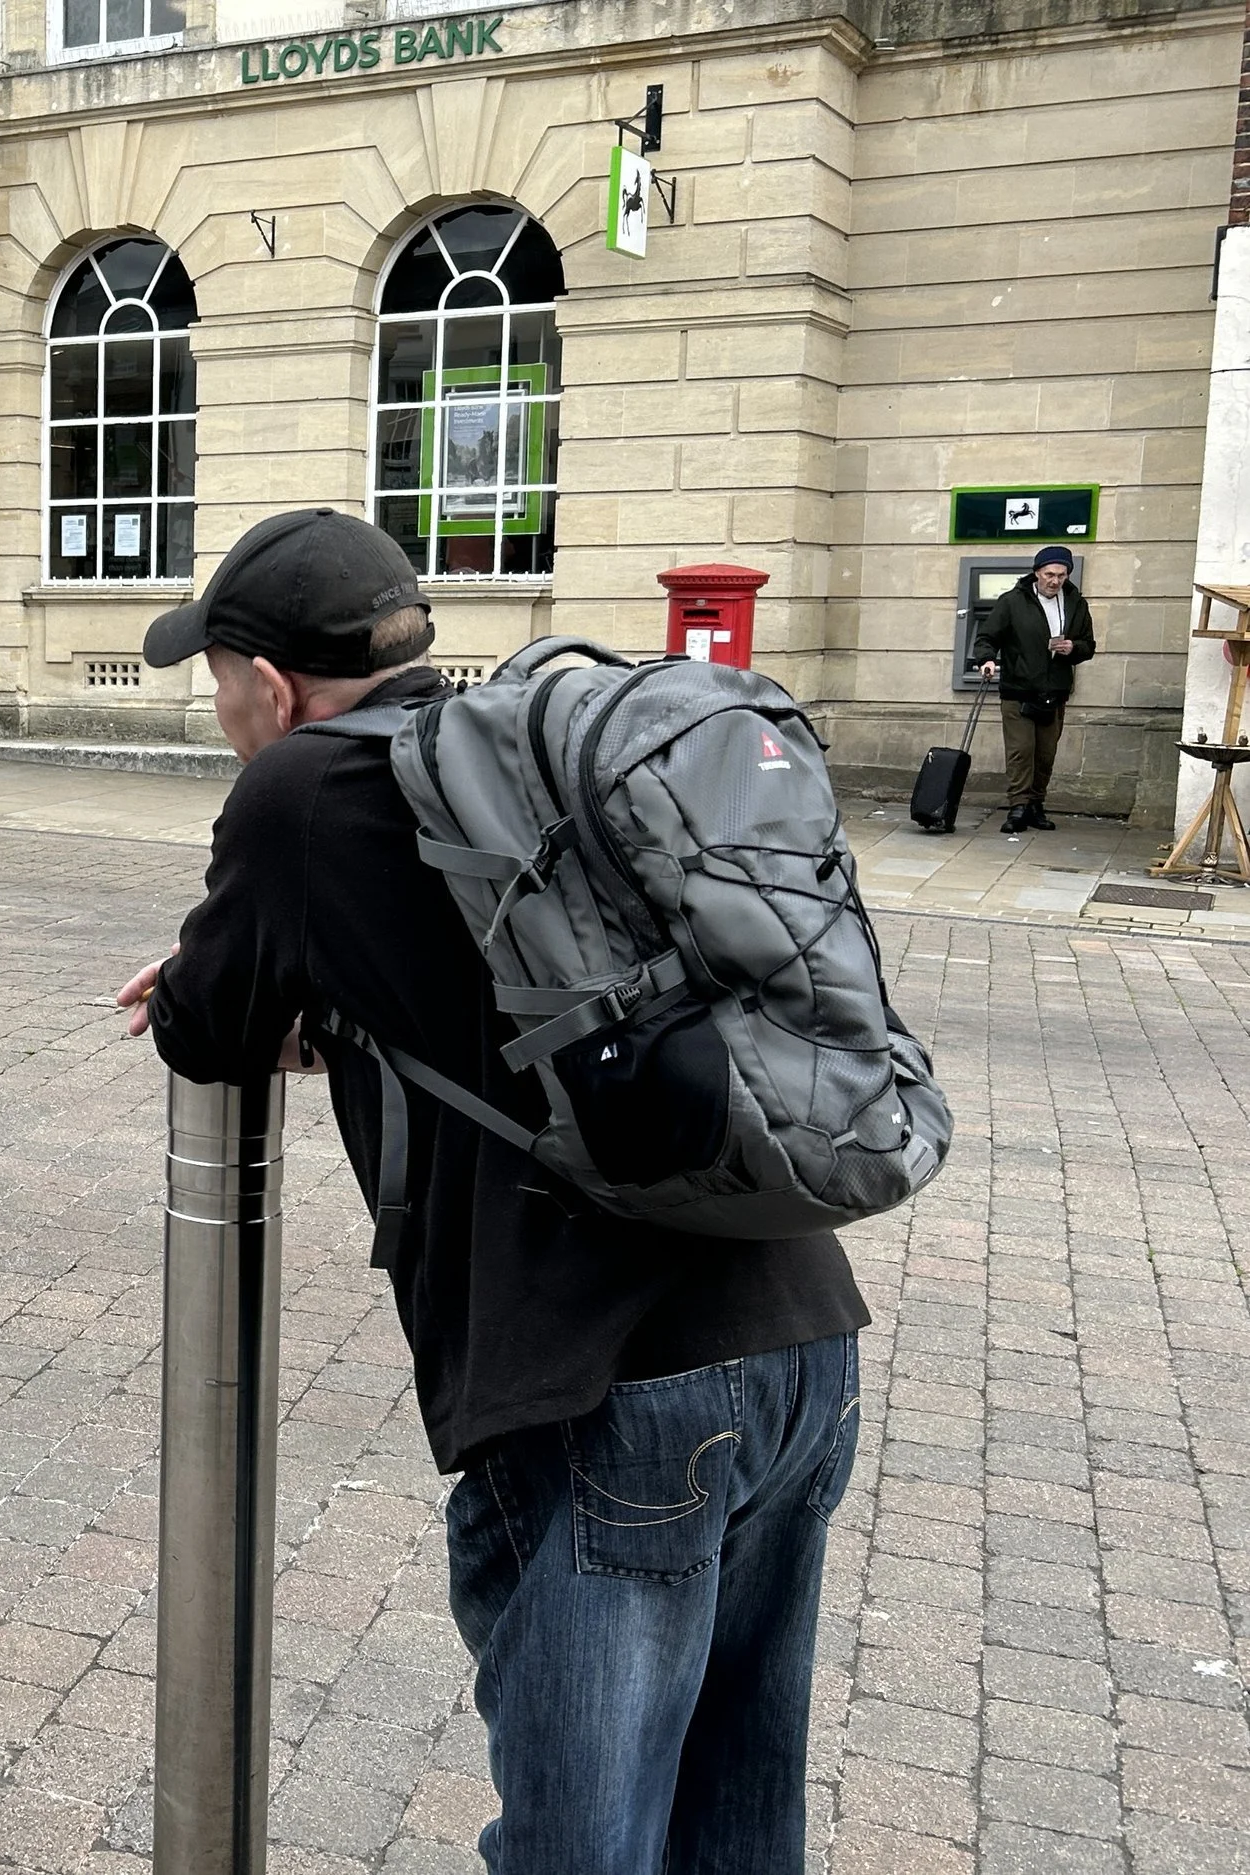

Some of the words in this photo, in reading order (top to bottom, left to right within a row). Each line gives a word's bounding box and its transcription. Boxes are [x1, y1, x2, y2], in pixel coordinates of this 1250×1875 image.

[241, 34, 381, 84] LLOYDS
[394, 17, 503, 65] BANK
[372, 585, 402, 609] SINCE
